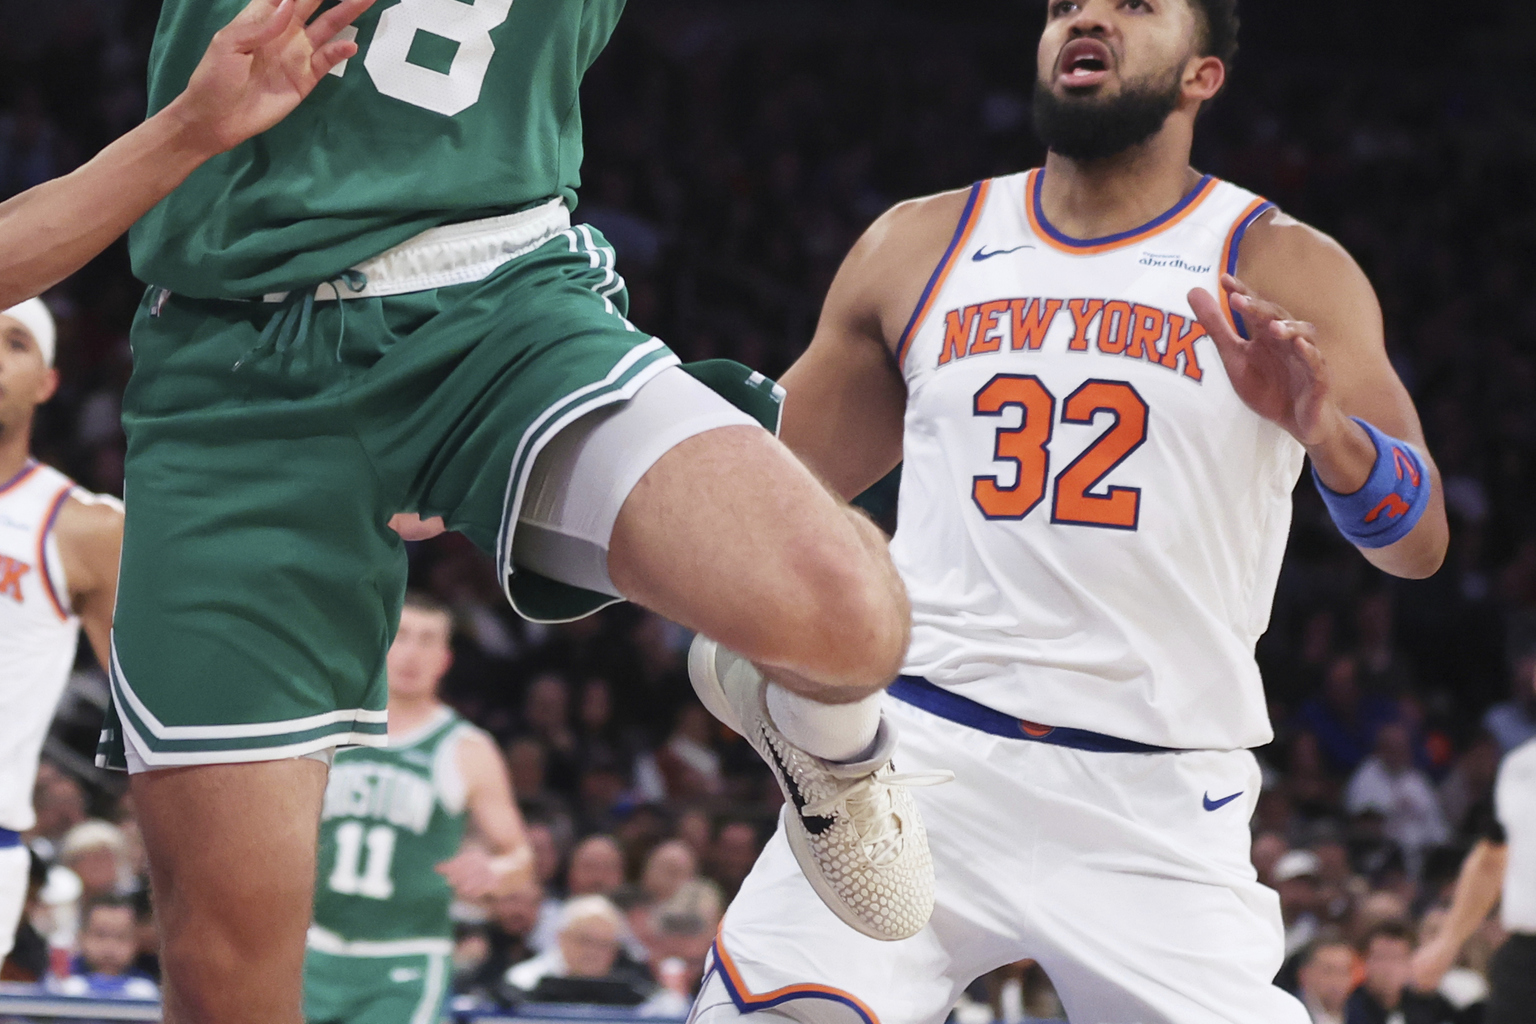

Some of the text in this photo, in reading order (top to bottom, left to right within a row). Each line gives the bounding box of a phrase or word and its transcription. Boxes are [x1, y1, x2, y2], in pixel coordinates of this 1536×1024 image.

[935, 297, 1207, 384] NEW YORK
[971, 373, 1150, 532] 32
[329, 821, 395, 900] 11
